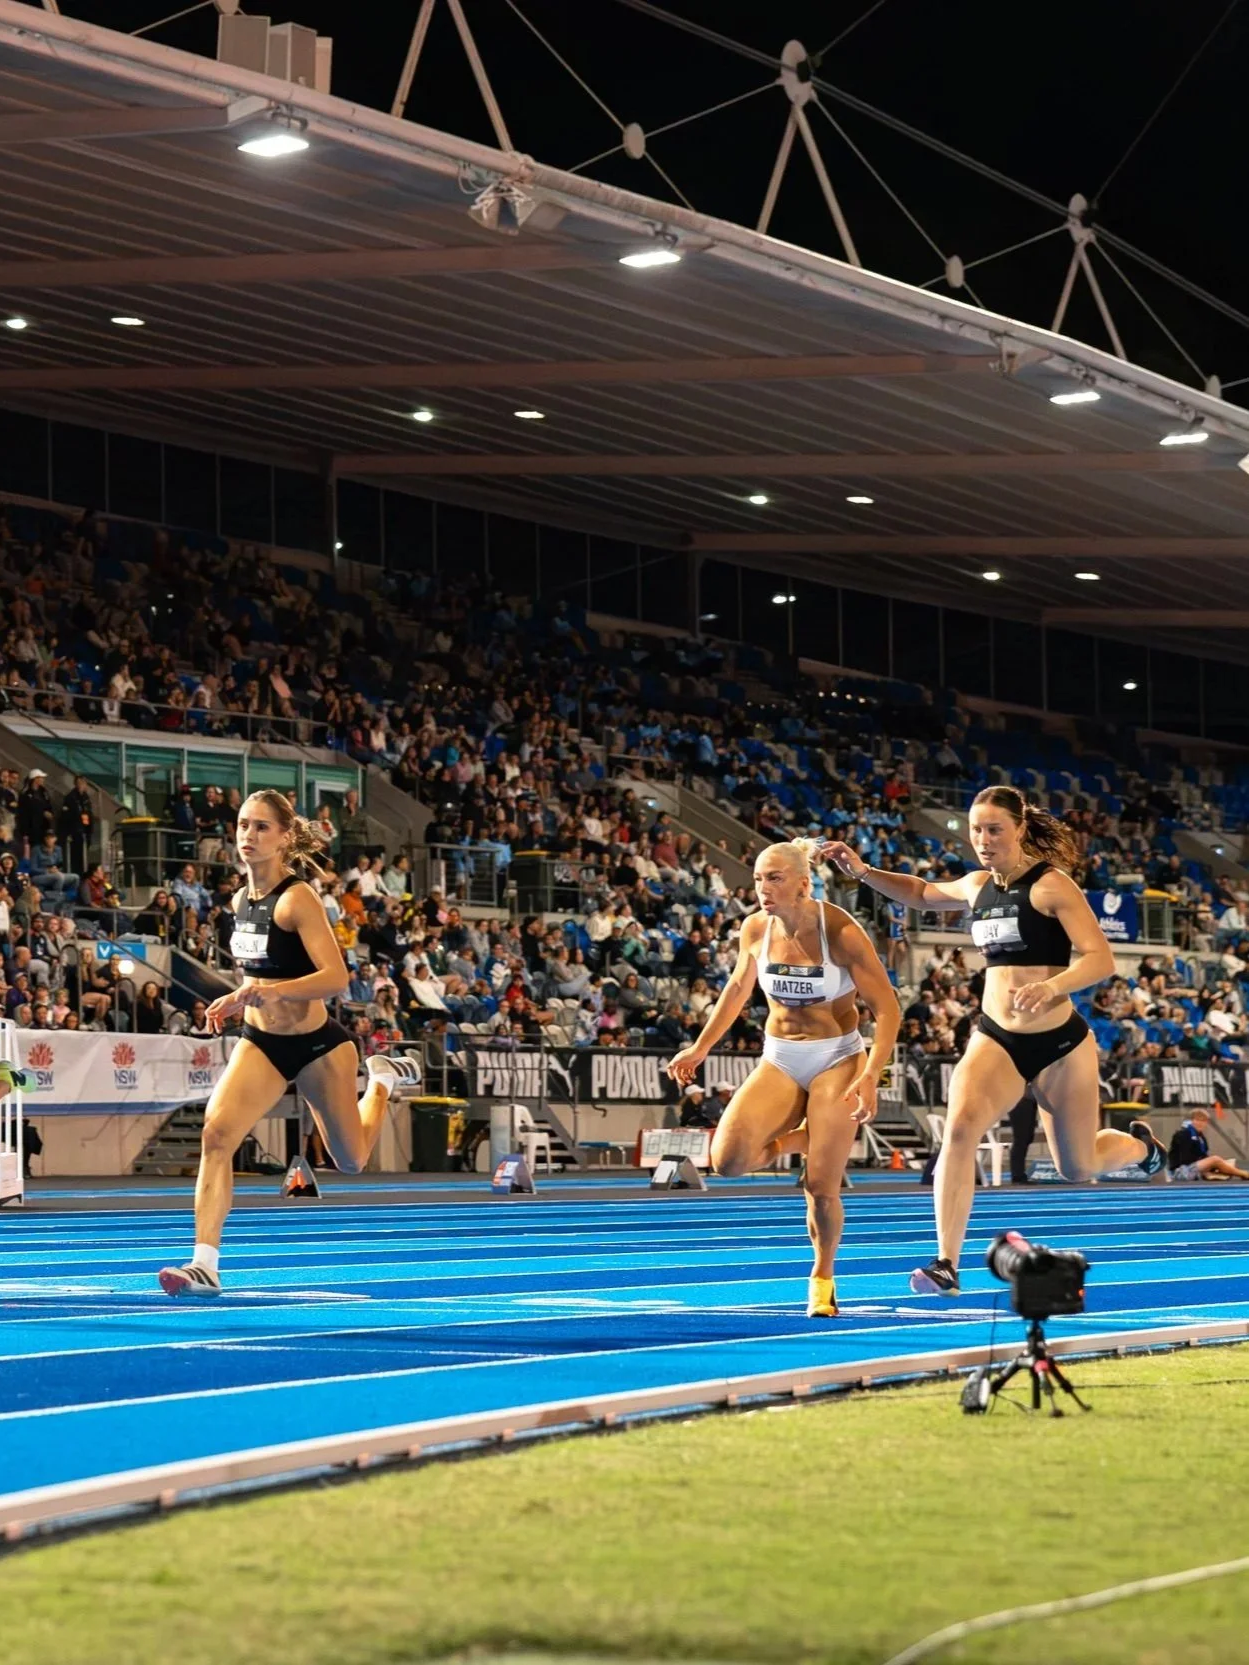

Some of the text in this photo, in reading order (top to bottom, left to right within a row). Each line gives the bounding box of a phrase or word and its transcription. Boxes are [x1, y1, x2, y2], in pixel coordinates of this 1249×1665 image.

[773, 979, 814, 994] MATZER
[36, 1070, 54, 1085] SW
[114, 1069, 137, 1084] NSW
[188, 1070, 212, 1084] NSW
[591, 1054, 663, 1099] PUMA
[705, 1055, 761, 1098] PUM
